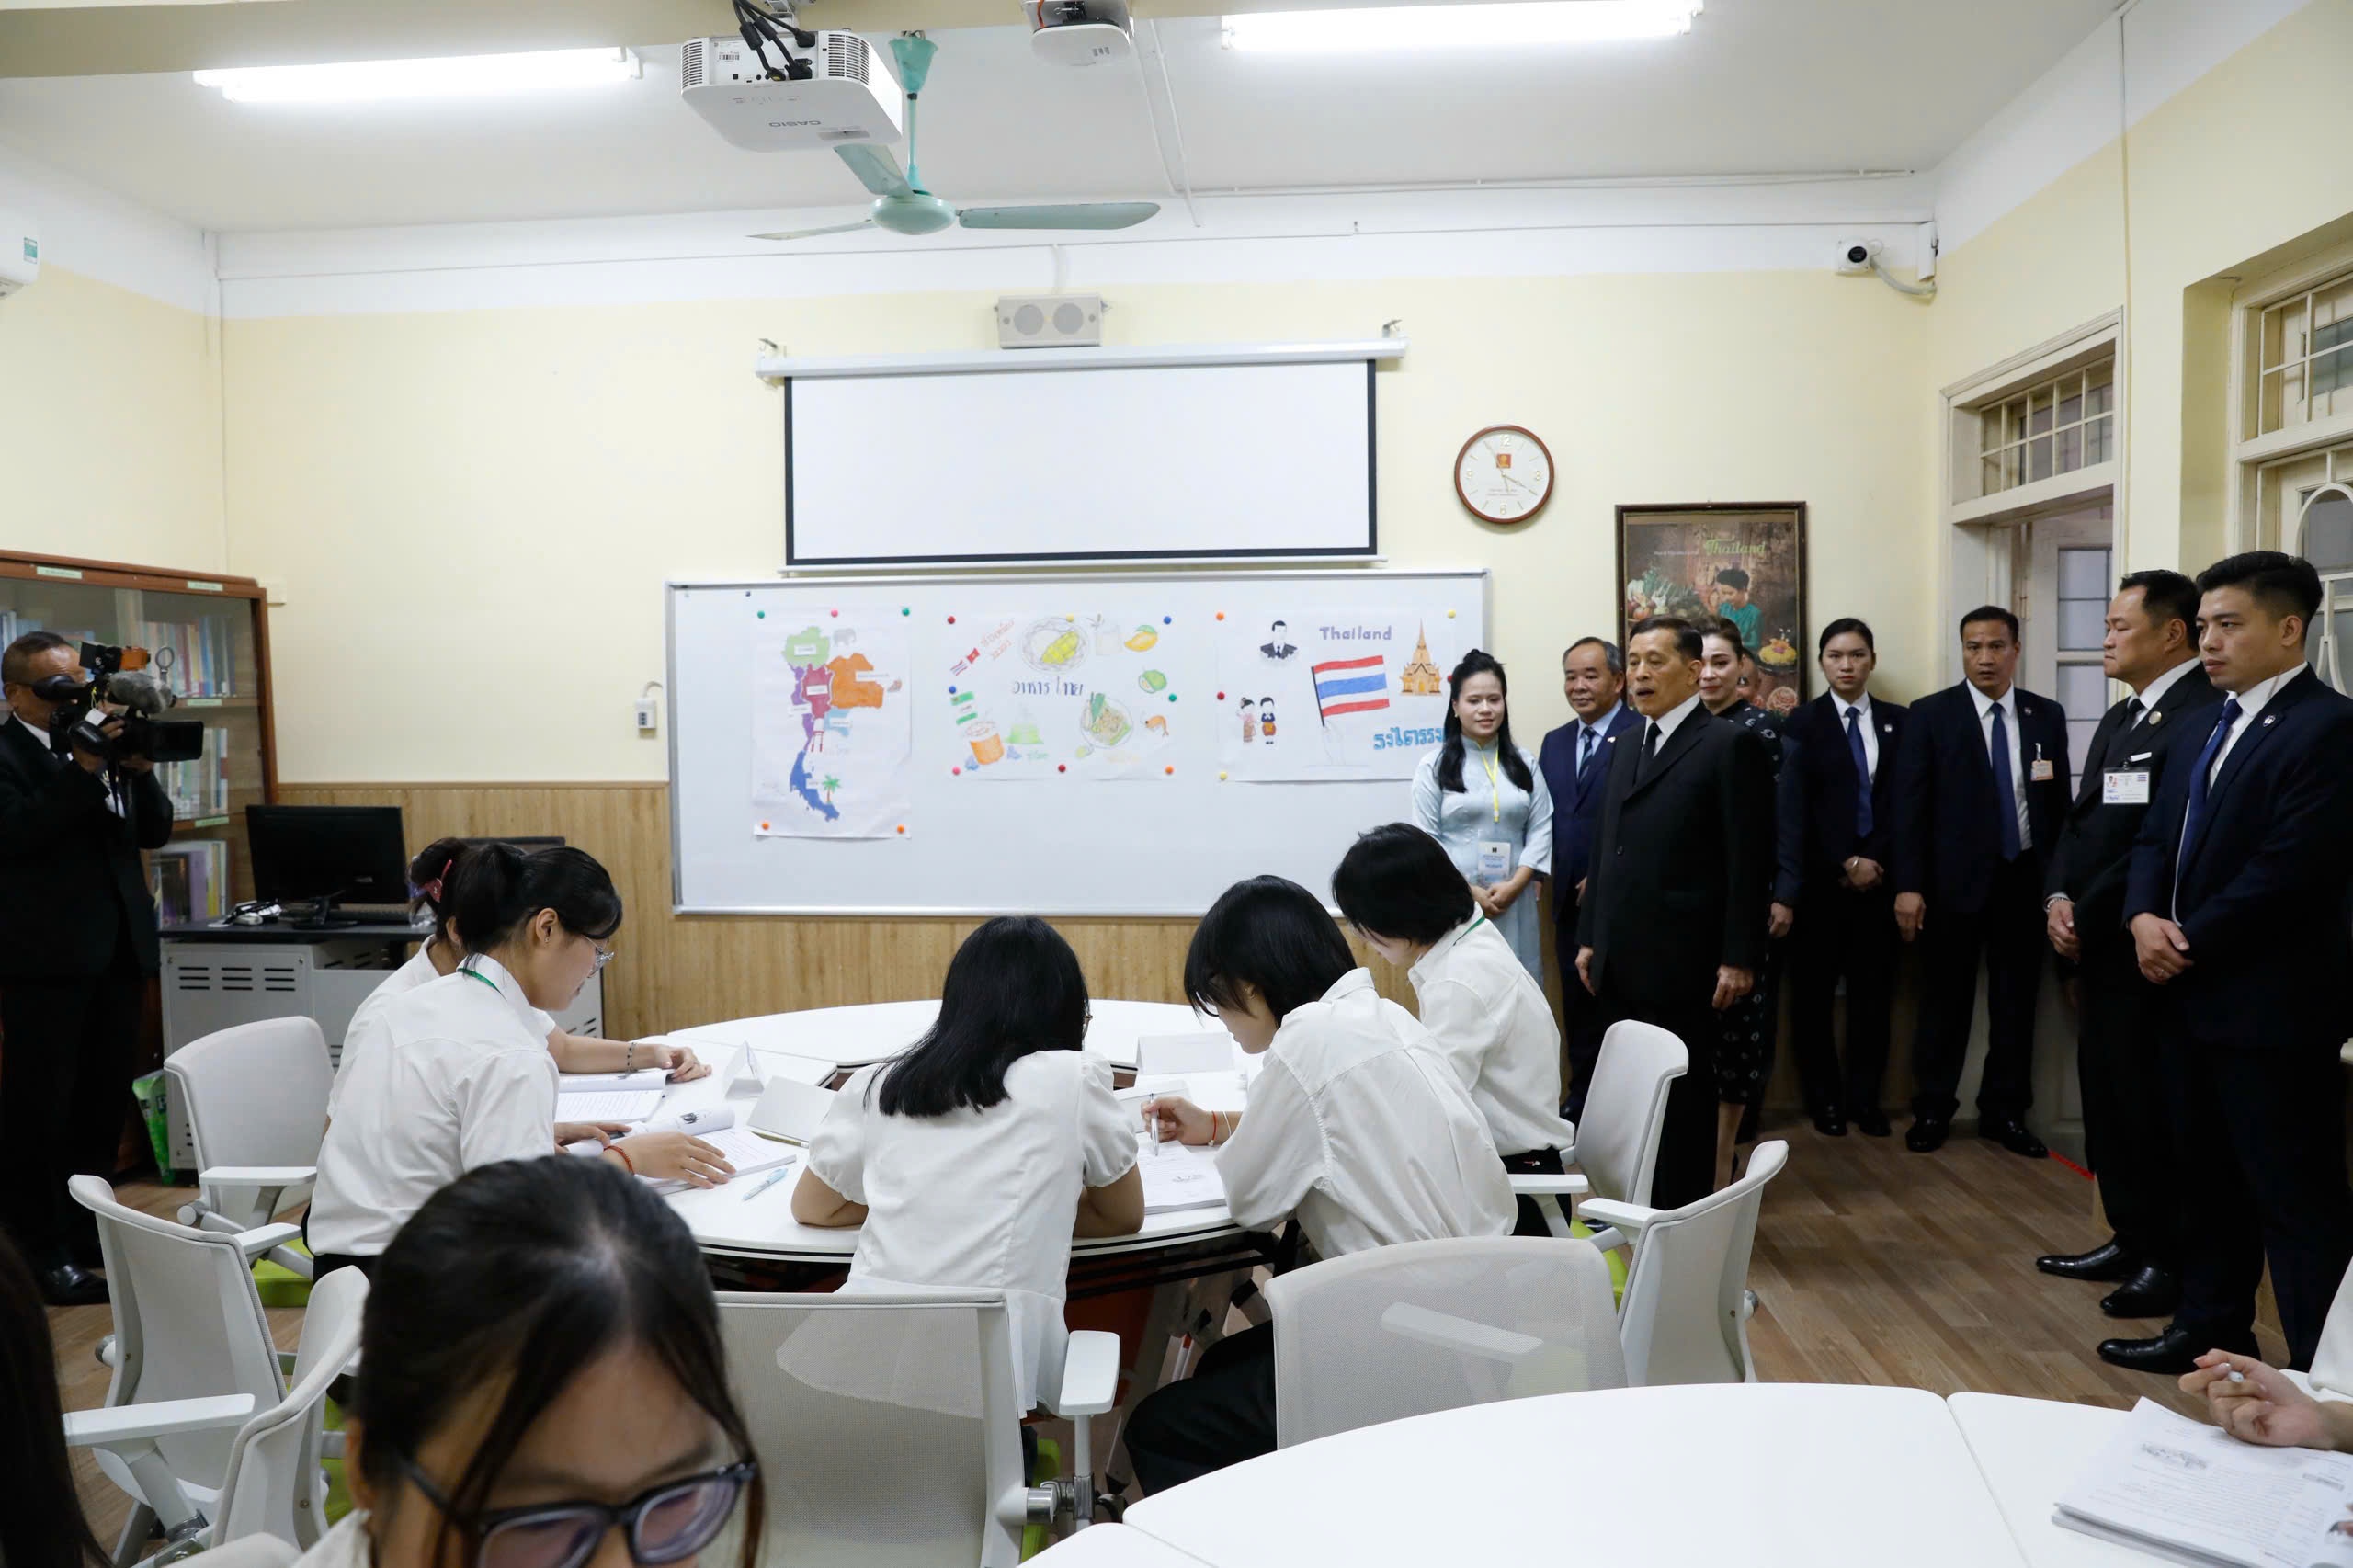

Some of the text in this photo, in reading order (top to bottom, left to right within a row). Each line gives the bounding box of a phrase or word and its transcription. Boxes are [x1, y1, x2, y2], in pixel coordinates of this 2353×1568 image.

[1703, 537, 1767, 556] Thailand
[1319, 626, 1392, 642] Thailand
[1373, 726, 1445, 750] ธงไตรรง
